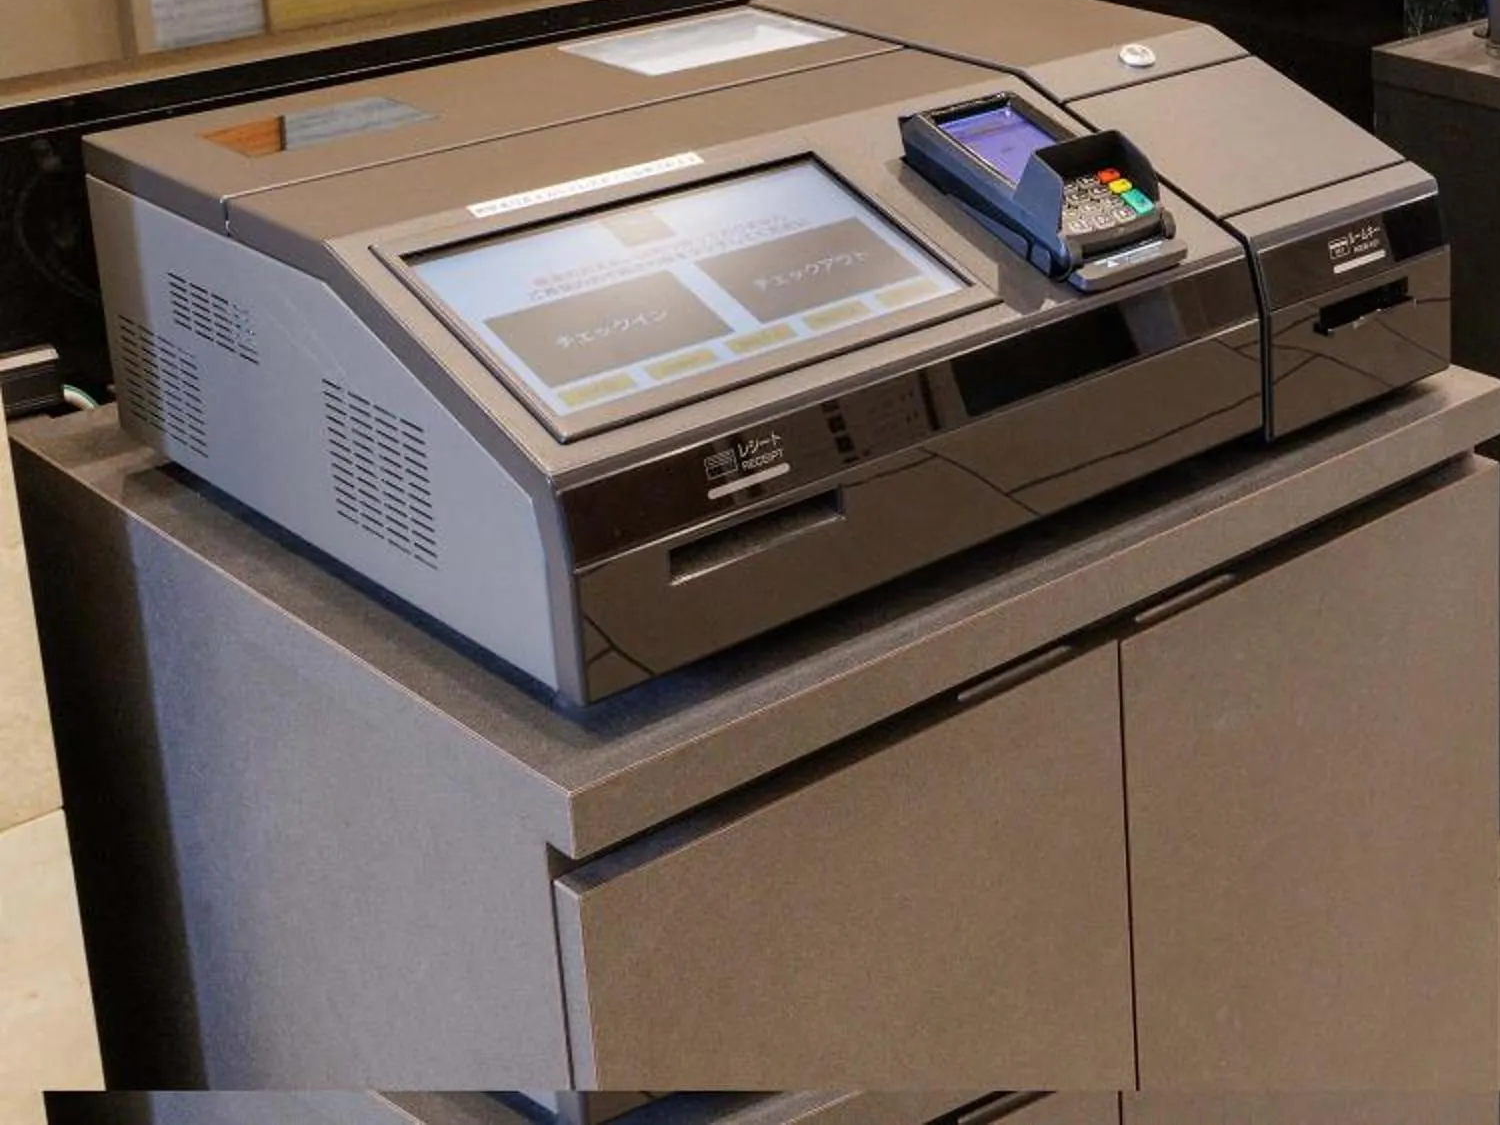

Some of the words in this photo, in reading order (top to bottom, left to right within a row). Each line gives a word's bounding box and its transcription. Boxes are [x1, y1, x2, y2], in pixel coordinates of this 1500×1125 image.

[753, 251, 869, 291] チェックアウト
[555, 309, 669, 350] チェックイン
[737, 431, 782, 458] レシート
